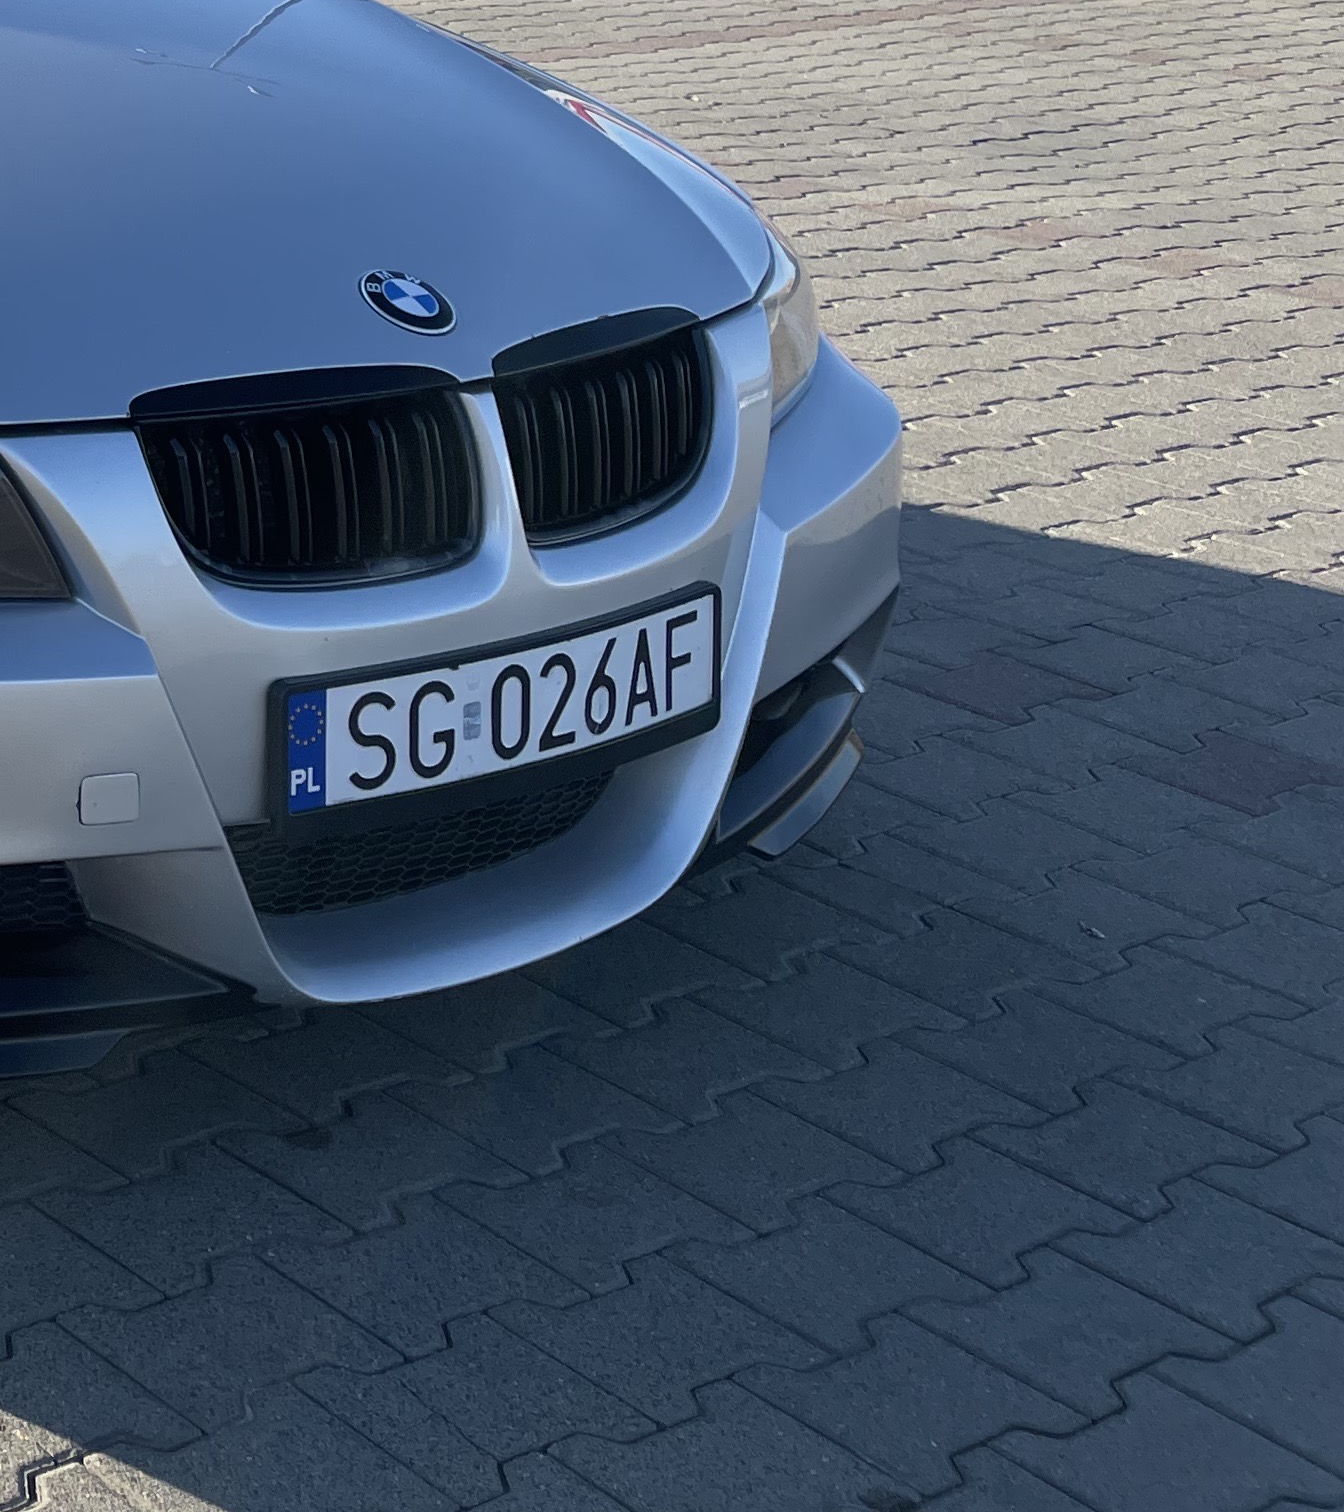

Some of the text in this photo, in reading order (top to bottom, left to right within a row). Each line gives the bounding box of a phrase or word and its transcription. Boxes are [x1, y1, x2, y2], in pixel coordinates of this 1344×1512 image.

[365, 270, 422, 294] BMW
[348, 609, 699, 791] SG 026AF
[290, 768, 321, 797] PL
